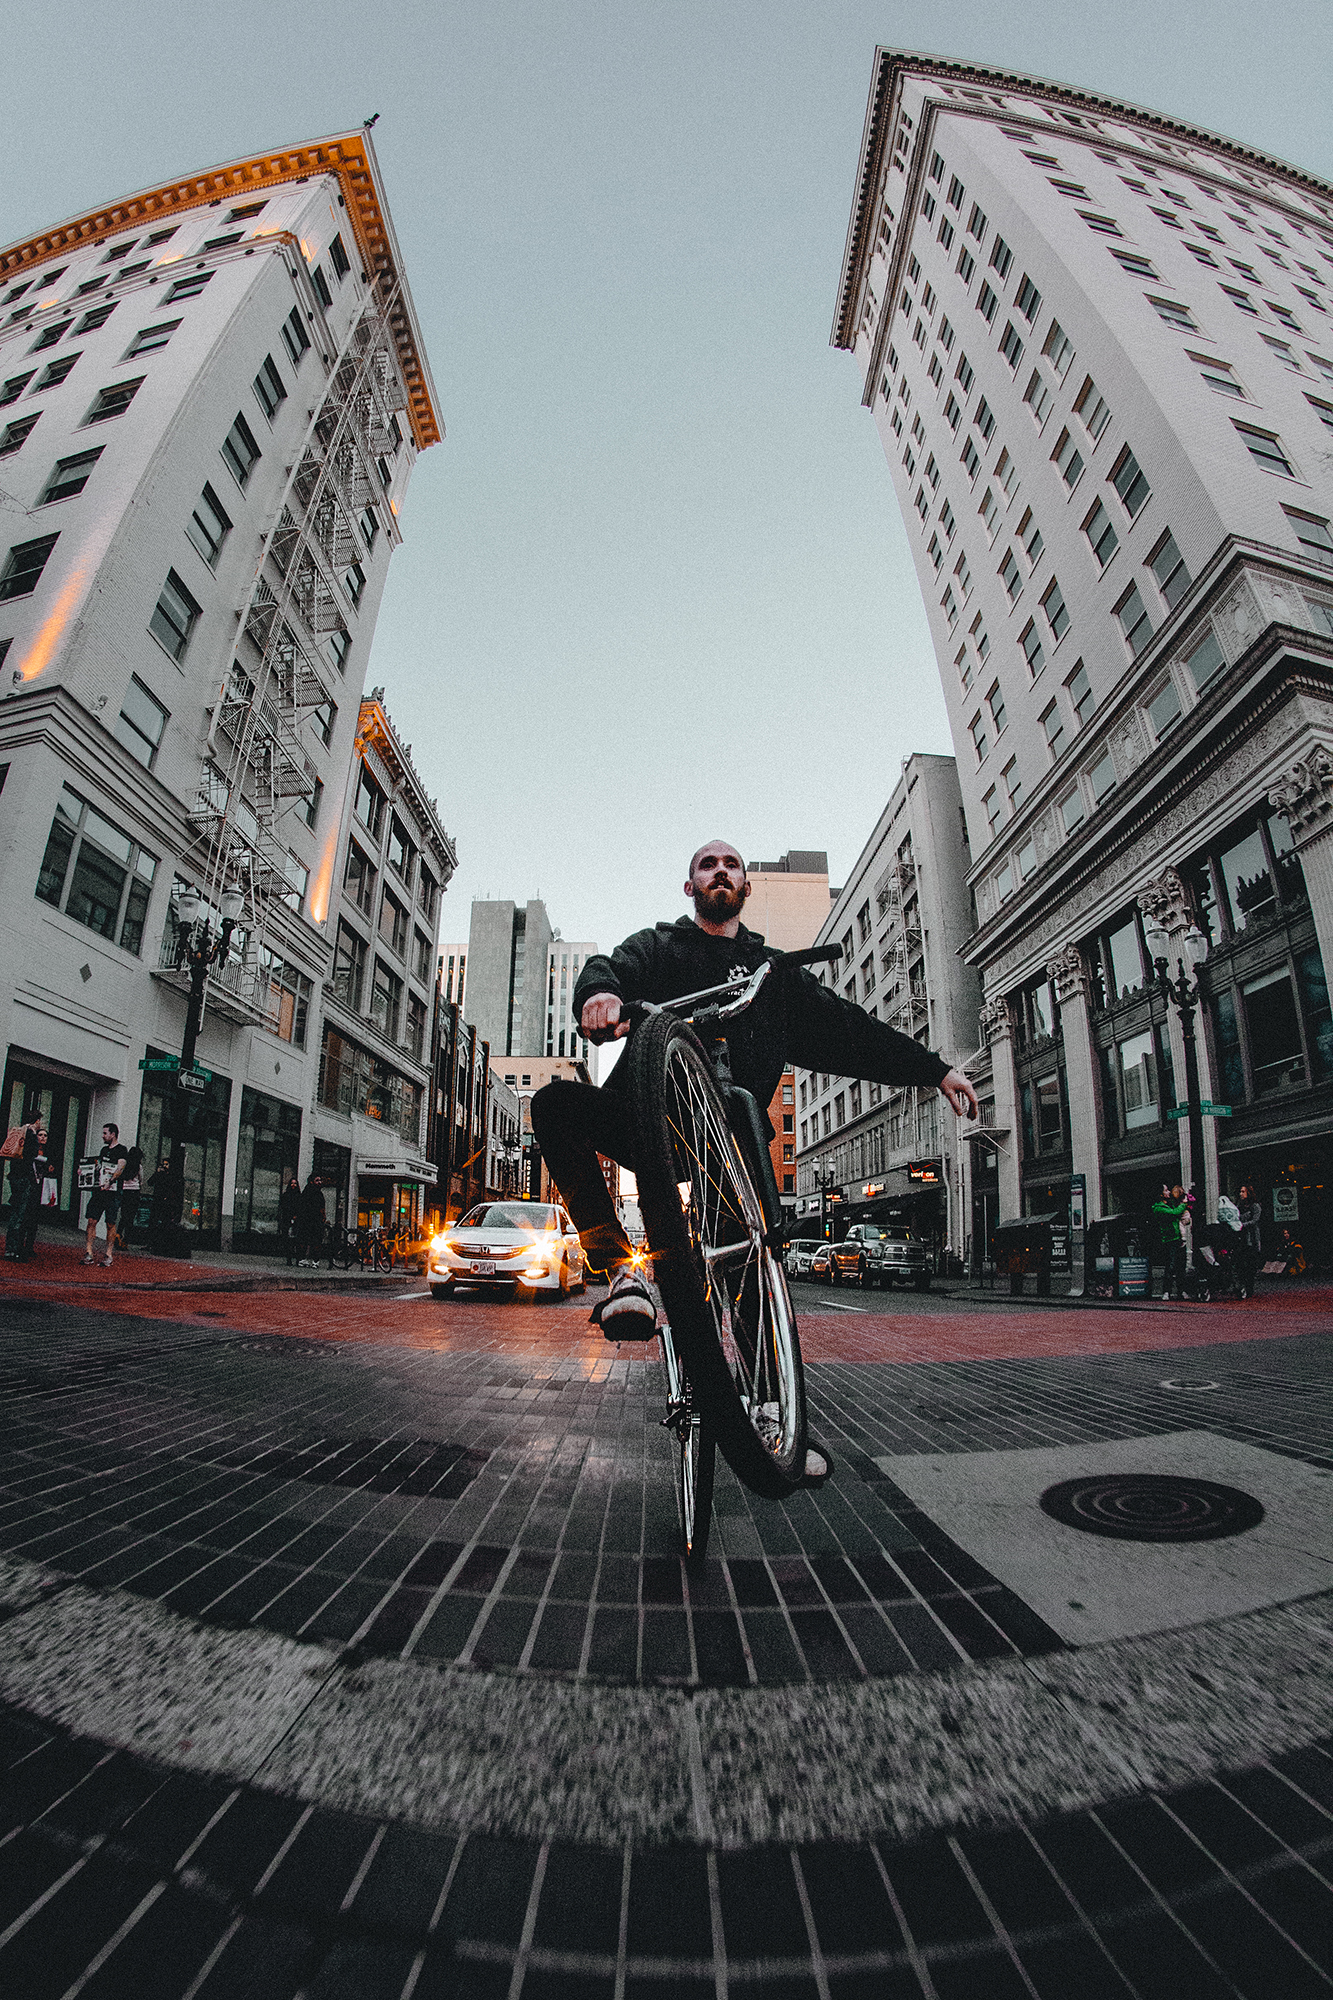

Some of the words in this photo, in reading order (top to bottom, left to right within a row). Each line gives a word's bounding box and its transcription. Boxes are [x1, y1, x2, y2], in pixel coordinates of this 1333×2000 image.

[185, 1075, 195, 1085] ONE
[195, 1078, 204, 1088] WAY
[911, 1171, 935, 1179] verizon
